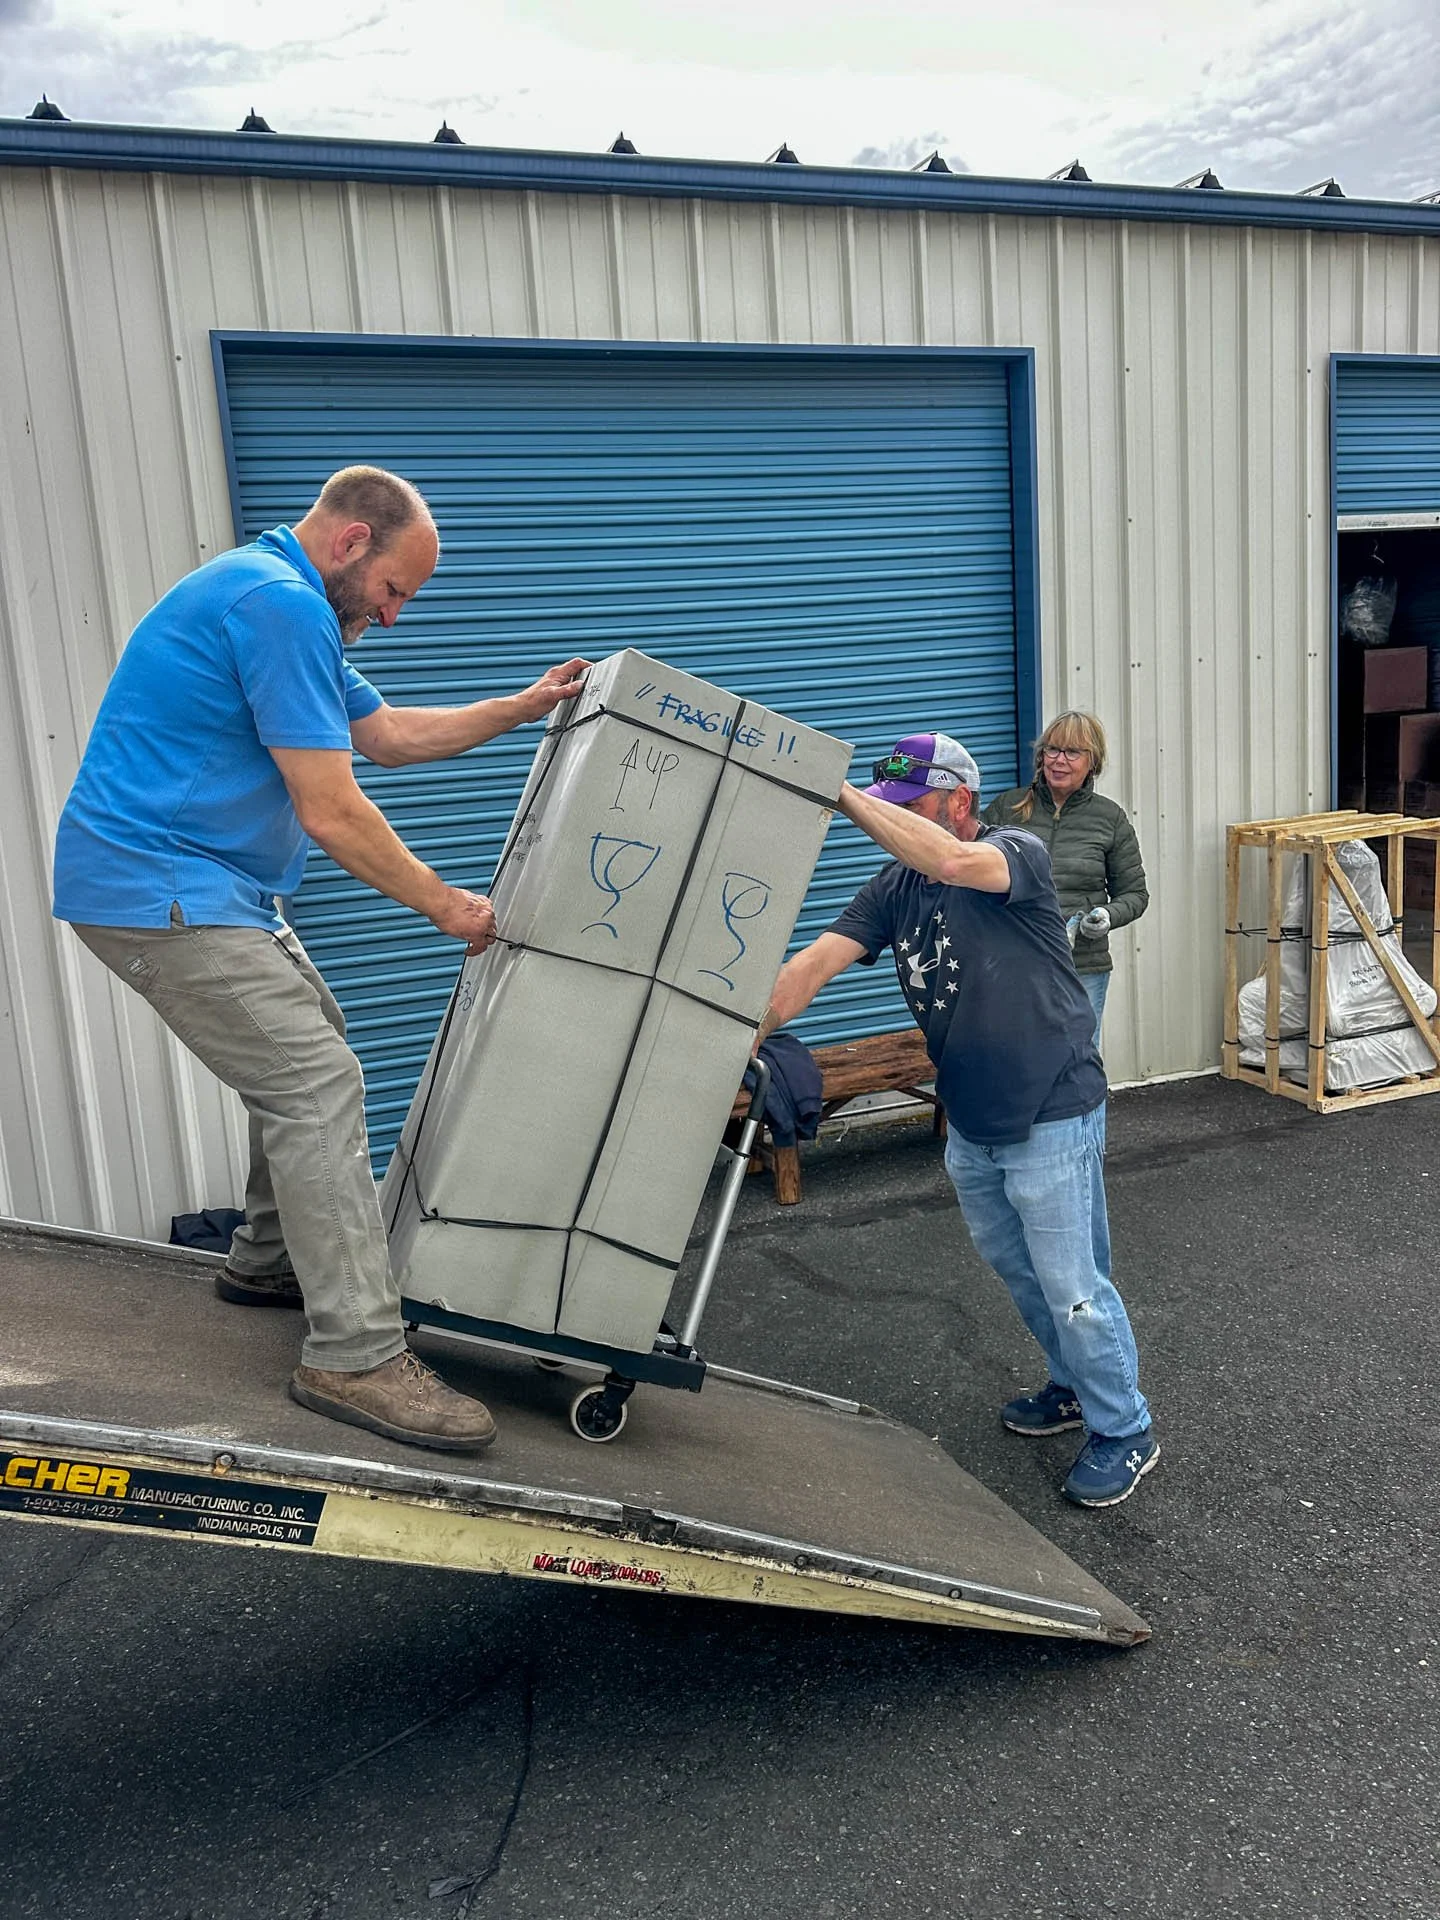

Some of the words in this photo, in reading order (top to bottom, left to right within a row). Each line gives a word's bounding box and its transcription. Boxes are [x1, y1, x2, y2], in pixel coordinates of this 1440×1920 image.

[0, 1457, 131, 1499] CHER
[130, 1487, 251, 1514] MANUFACTURING
[280, 1505, 306, 1521] INC.
[197, 1516, 285, 1540] INDIANAPOLIS,
[287, 1527, 303, 1540] IN
